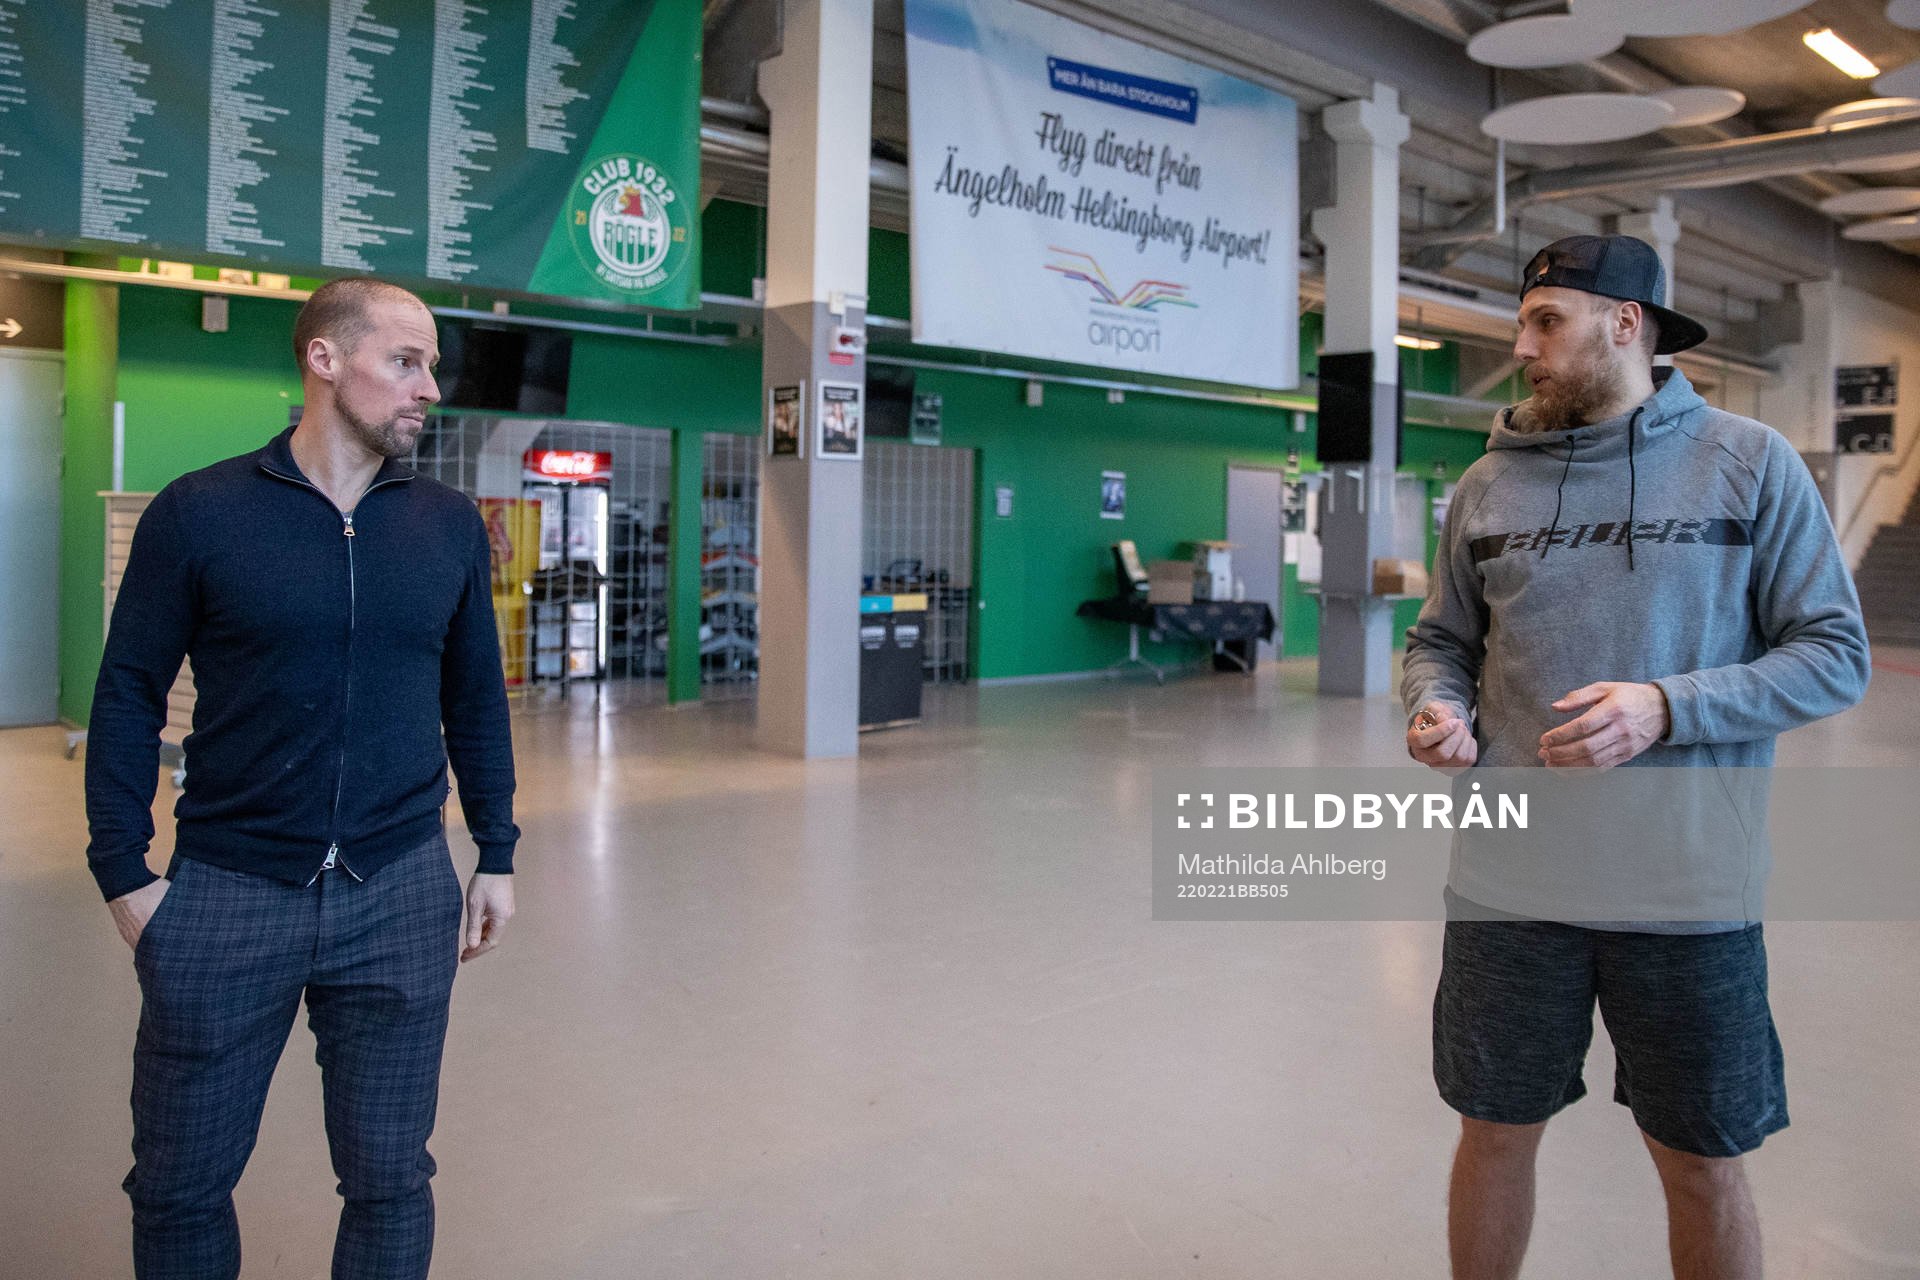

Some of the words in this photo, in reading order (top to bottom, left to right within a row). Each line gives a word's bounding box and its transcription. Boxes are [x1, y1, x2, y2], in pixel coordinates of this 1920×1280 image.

[1054, 68, 1080, 86] MER
[1035, 111, 1088, 177] Flyg
[1095, 129, 1154, 176] direkt
[1156, 145, 1200, 195] från
[583, 157, 630, 195] CLUB
[635, 162, 675, 206] 1932
[935, 146, 1065, 218] Ängelholm
[1071, 188, 1194, 263] Helsingborg
[1199, 218, 1271, 268] Airport!
[1088, 320, 1160, 354] airport
